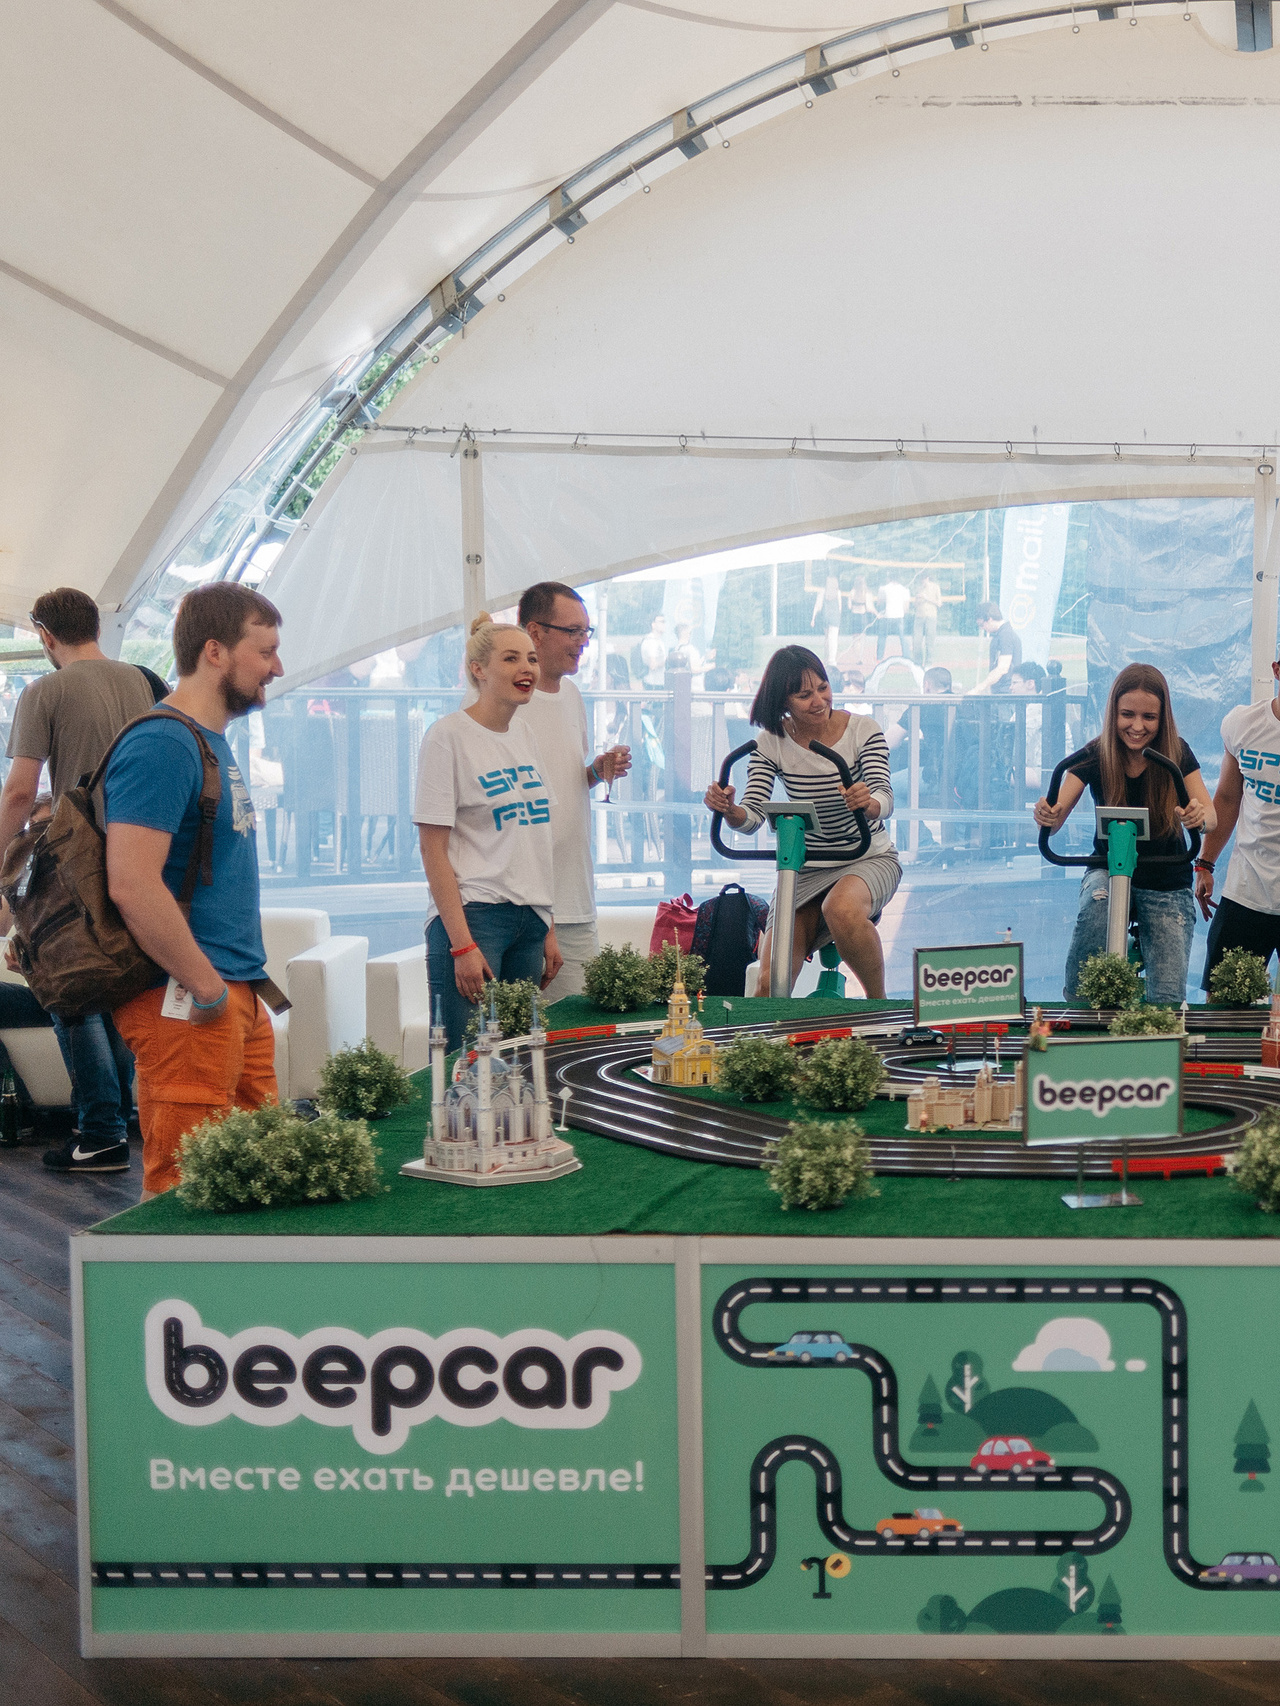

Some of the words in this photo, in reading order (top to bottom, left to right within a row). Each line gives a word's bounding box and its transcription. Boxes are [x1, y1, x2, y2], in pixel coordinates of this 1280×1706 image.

[923, 967, 1014, 992] beepcar
[920, 999, 951, 1007] Вместе
[952, 997, 977, 1005] ехать
[978, 993, 1018, 1004] дешевле!
[1038, 1080, 1170, 1112] beepcar
[163, 1316, 624, 1437] beepcar
[149, 1459, 300, 1491] Вместе
[313, 1468, 433, 1491] ехать
[445, 1460, 644, 1497] дешевле!
